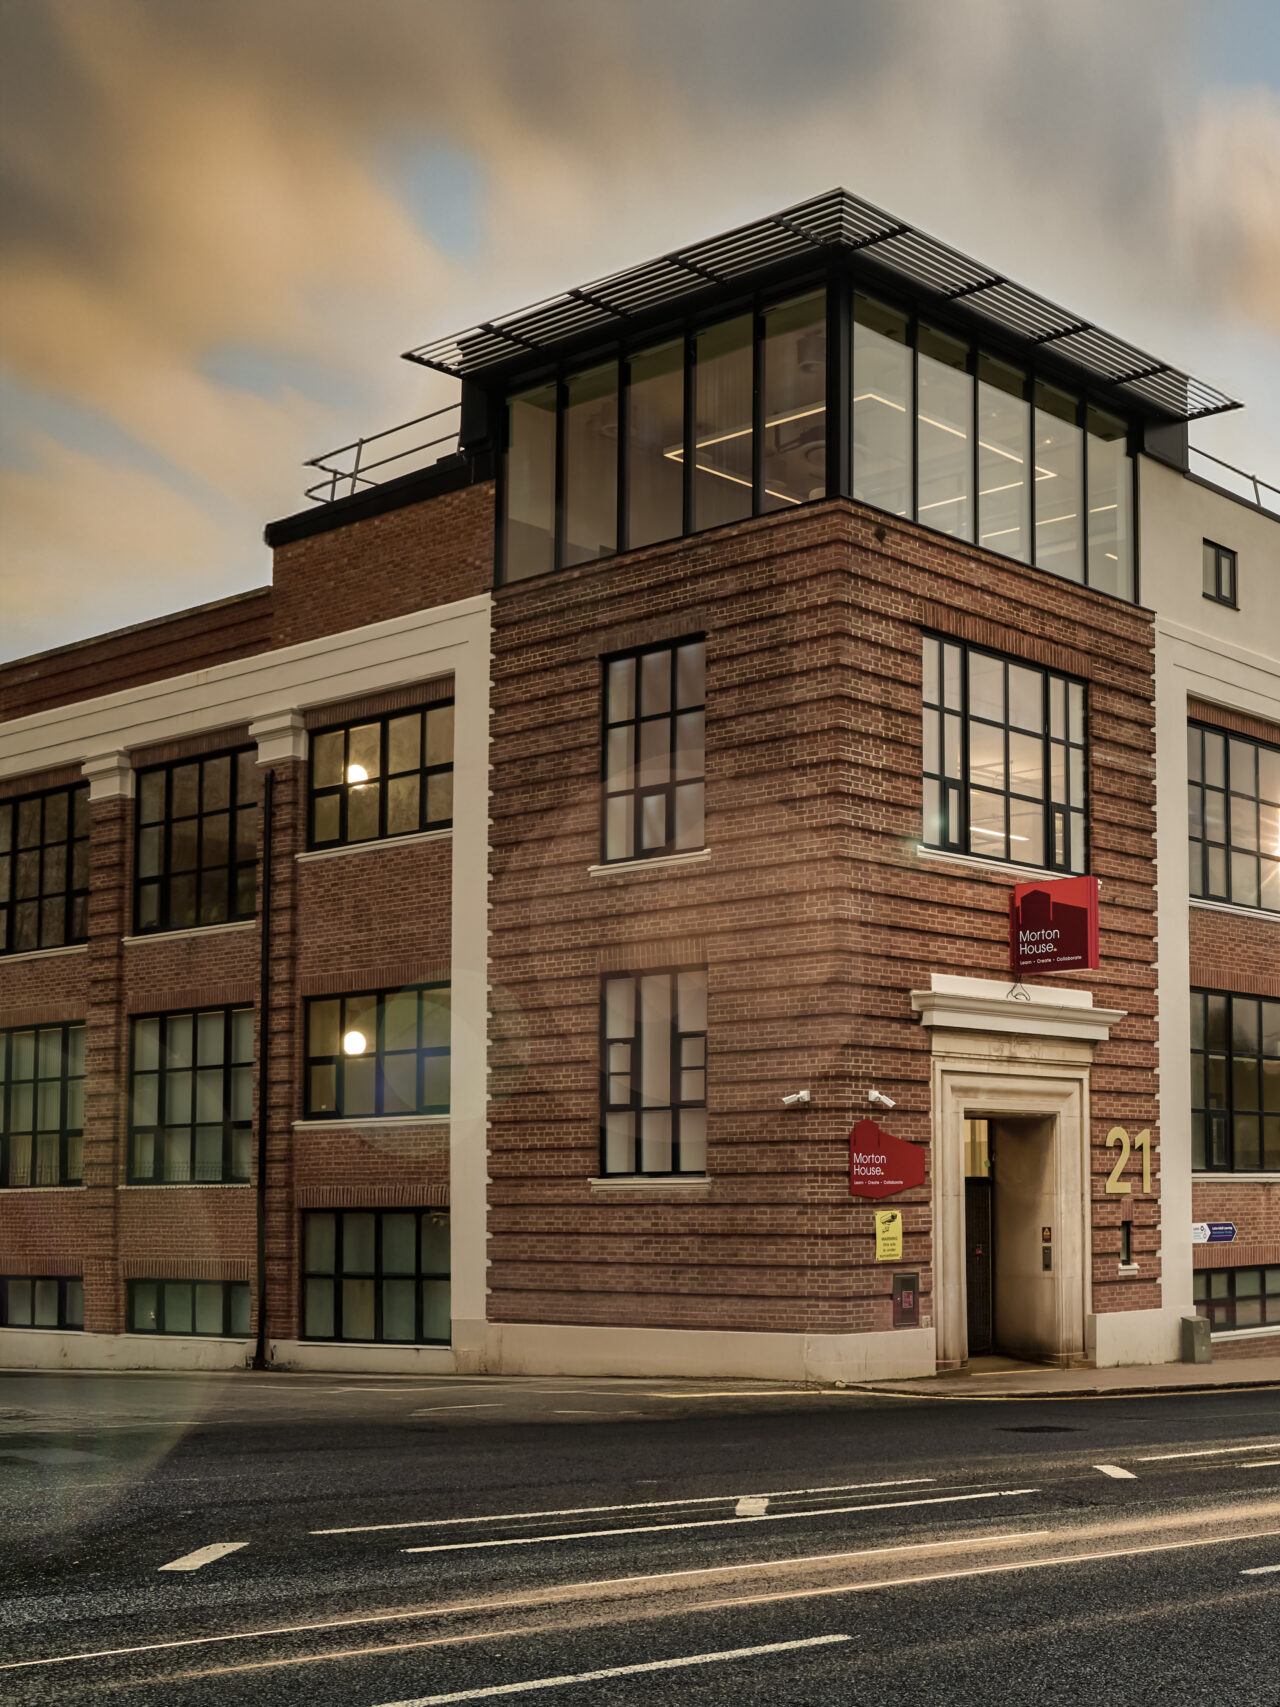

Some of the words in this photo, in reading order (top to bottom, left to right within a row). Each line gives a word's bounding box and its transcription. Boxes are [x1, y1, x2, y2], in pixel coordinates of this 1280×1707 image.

[1019, 929, 1060, 942] Morton
[1019, 943, 1058, 955] House.
[853, 1152, 887, 1164] Morton
[1105, 1126, 1151, 1194] 21
[853, 1164, 885, 1176] House.
